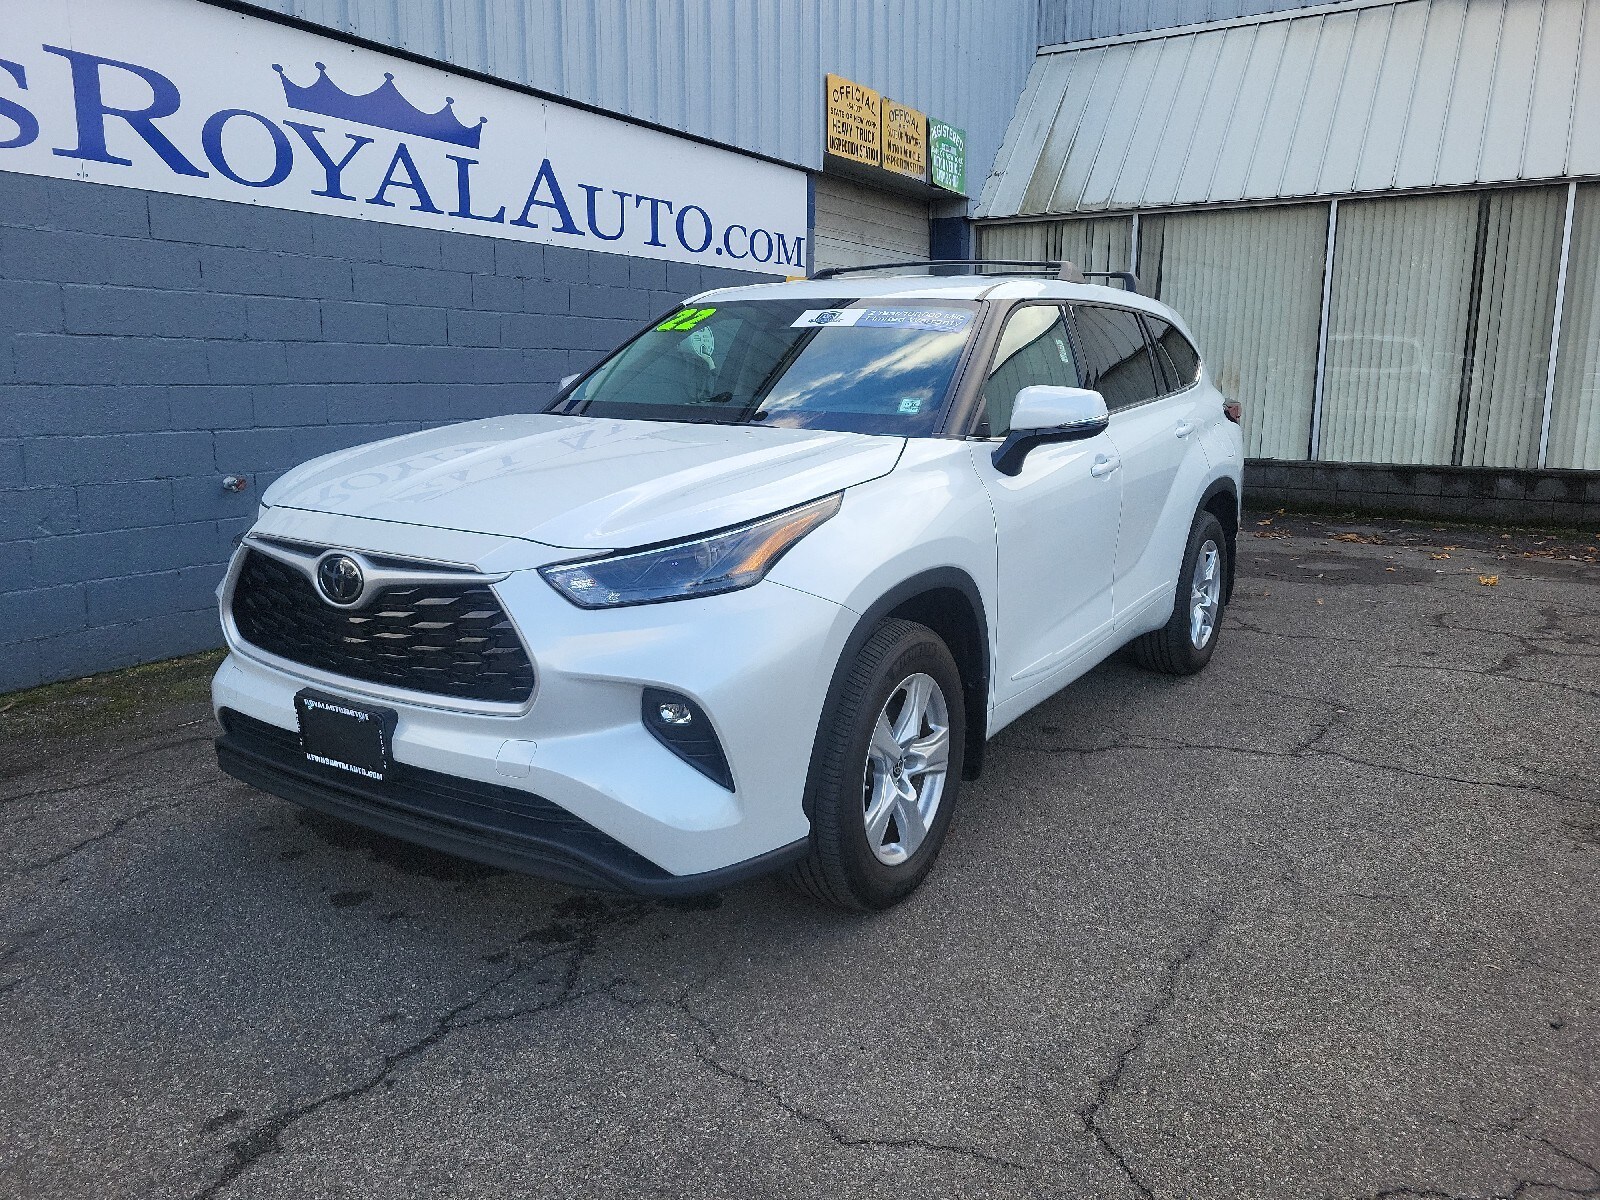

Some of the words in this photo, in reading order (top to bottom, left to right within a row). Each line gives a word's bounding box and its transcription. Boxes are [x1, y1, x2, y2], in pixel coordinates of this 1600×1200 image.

[832, 85, 876, 116] OFFICIAL
[830, 106, 845, 118] STATE
[845, 112, 853, 120] OF
[853, 114, 864, 125] NEW
[888, 108, 921, 136] OFFICIAL
[832, 117, 853, 138] HEAVY
[855, 125, 876, 145] TRUCK
[931, 124, 964, 152] REGISTERED
[829, 134, 859, 157] INSPECTION
[859, 143, 879, 162] STATION
[883, 152, 910, 171] INSPECTION
[656, 307, 717, 332] 22
[865, 315, 905, 323] Limited
[909, 317, 962, 327] Warranty
